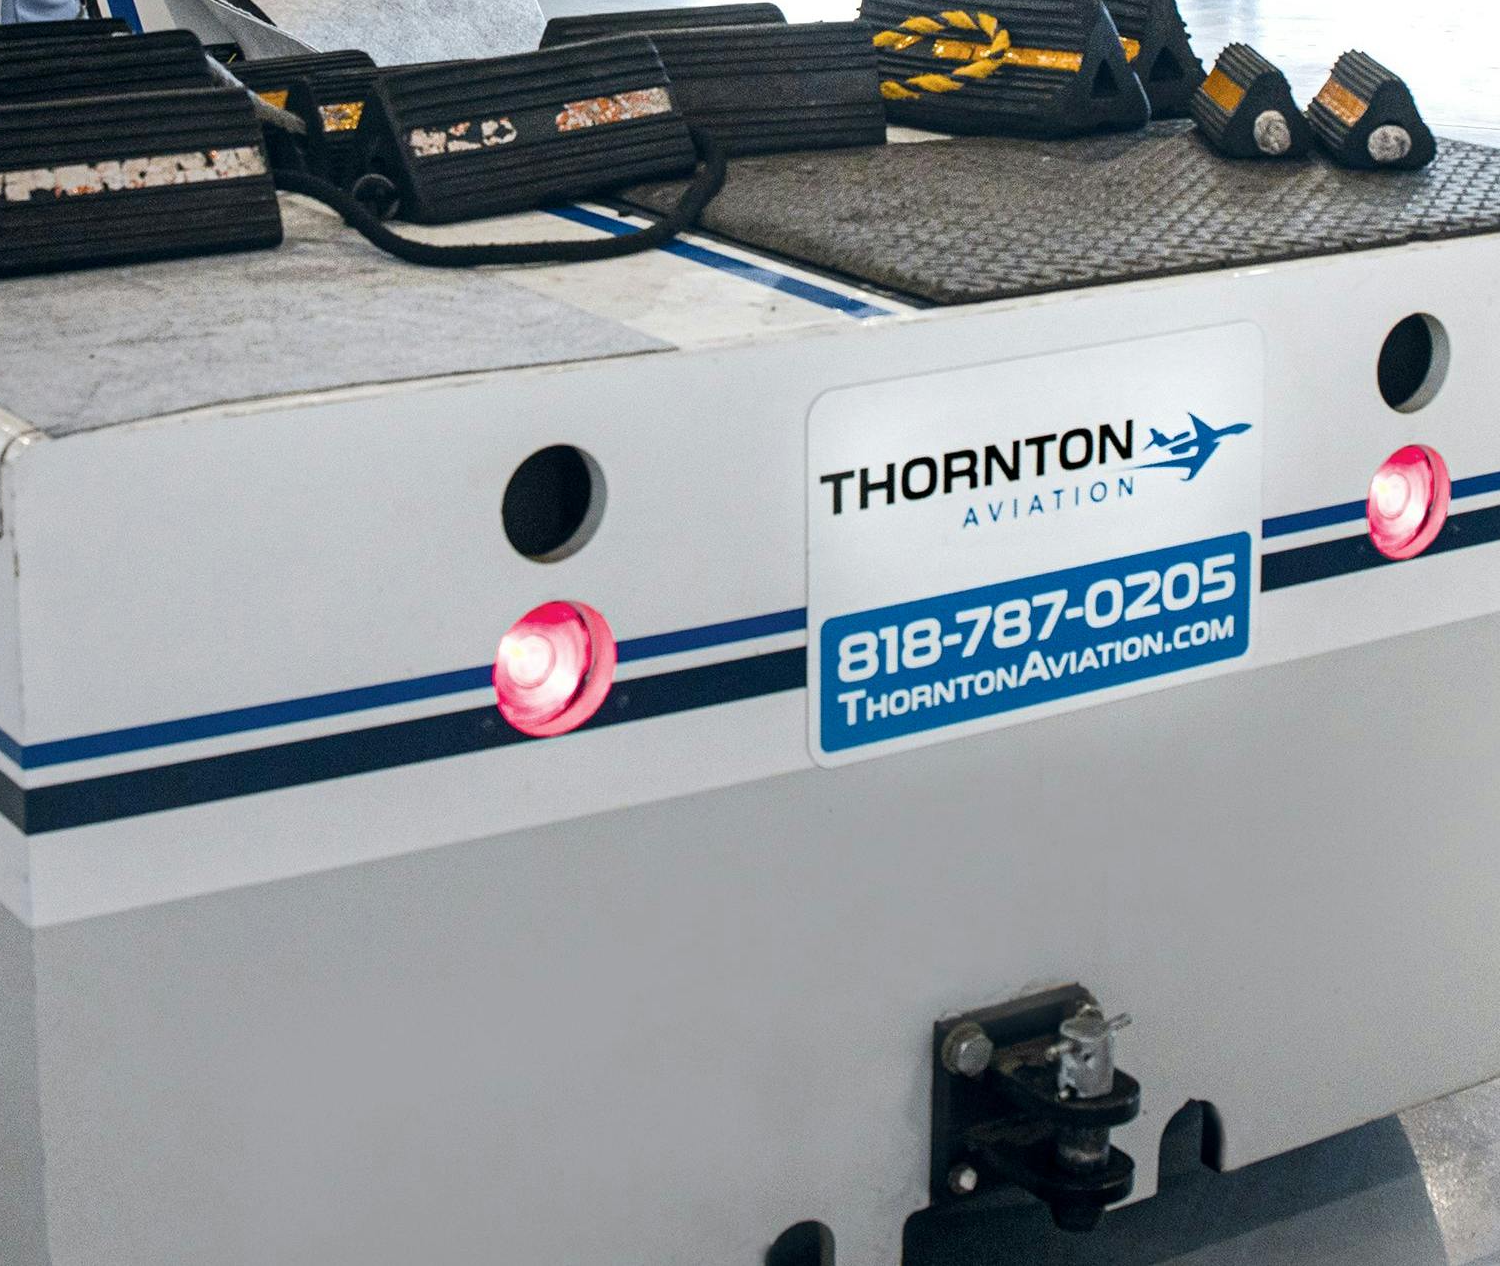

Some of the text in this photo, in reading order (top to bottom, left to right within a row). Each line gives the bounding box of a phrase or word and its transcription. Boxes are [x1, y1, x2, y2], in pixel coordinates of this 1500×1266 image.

[819, 419, 1134, 515] THORNTON
[963, 476, 1134, 528] AVIATION
[837, 553, 1236, 684] 818-787-0205
